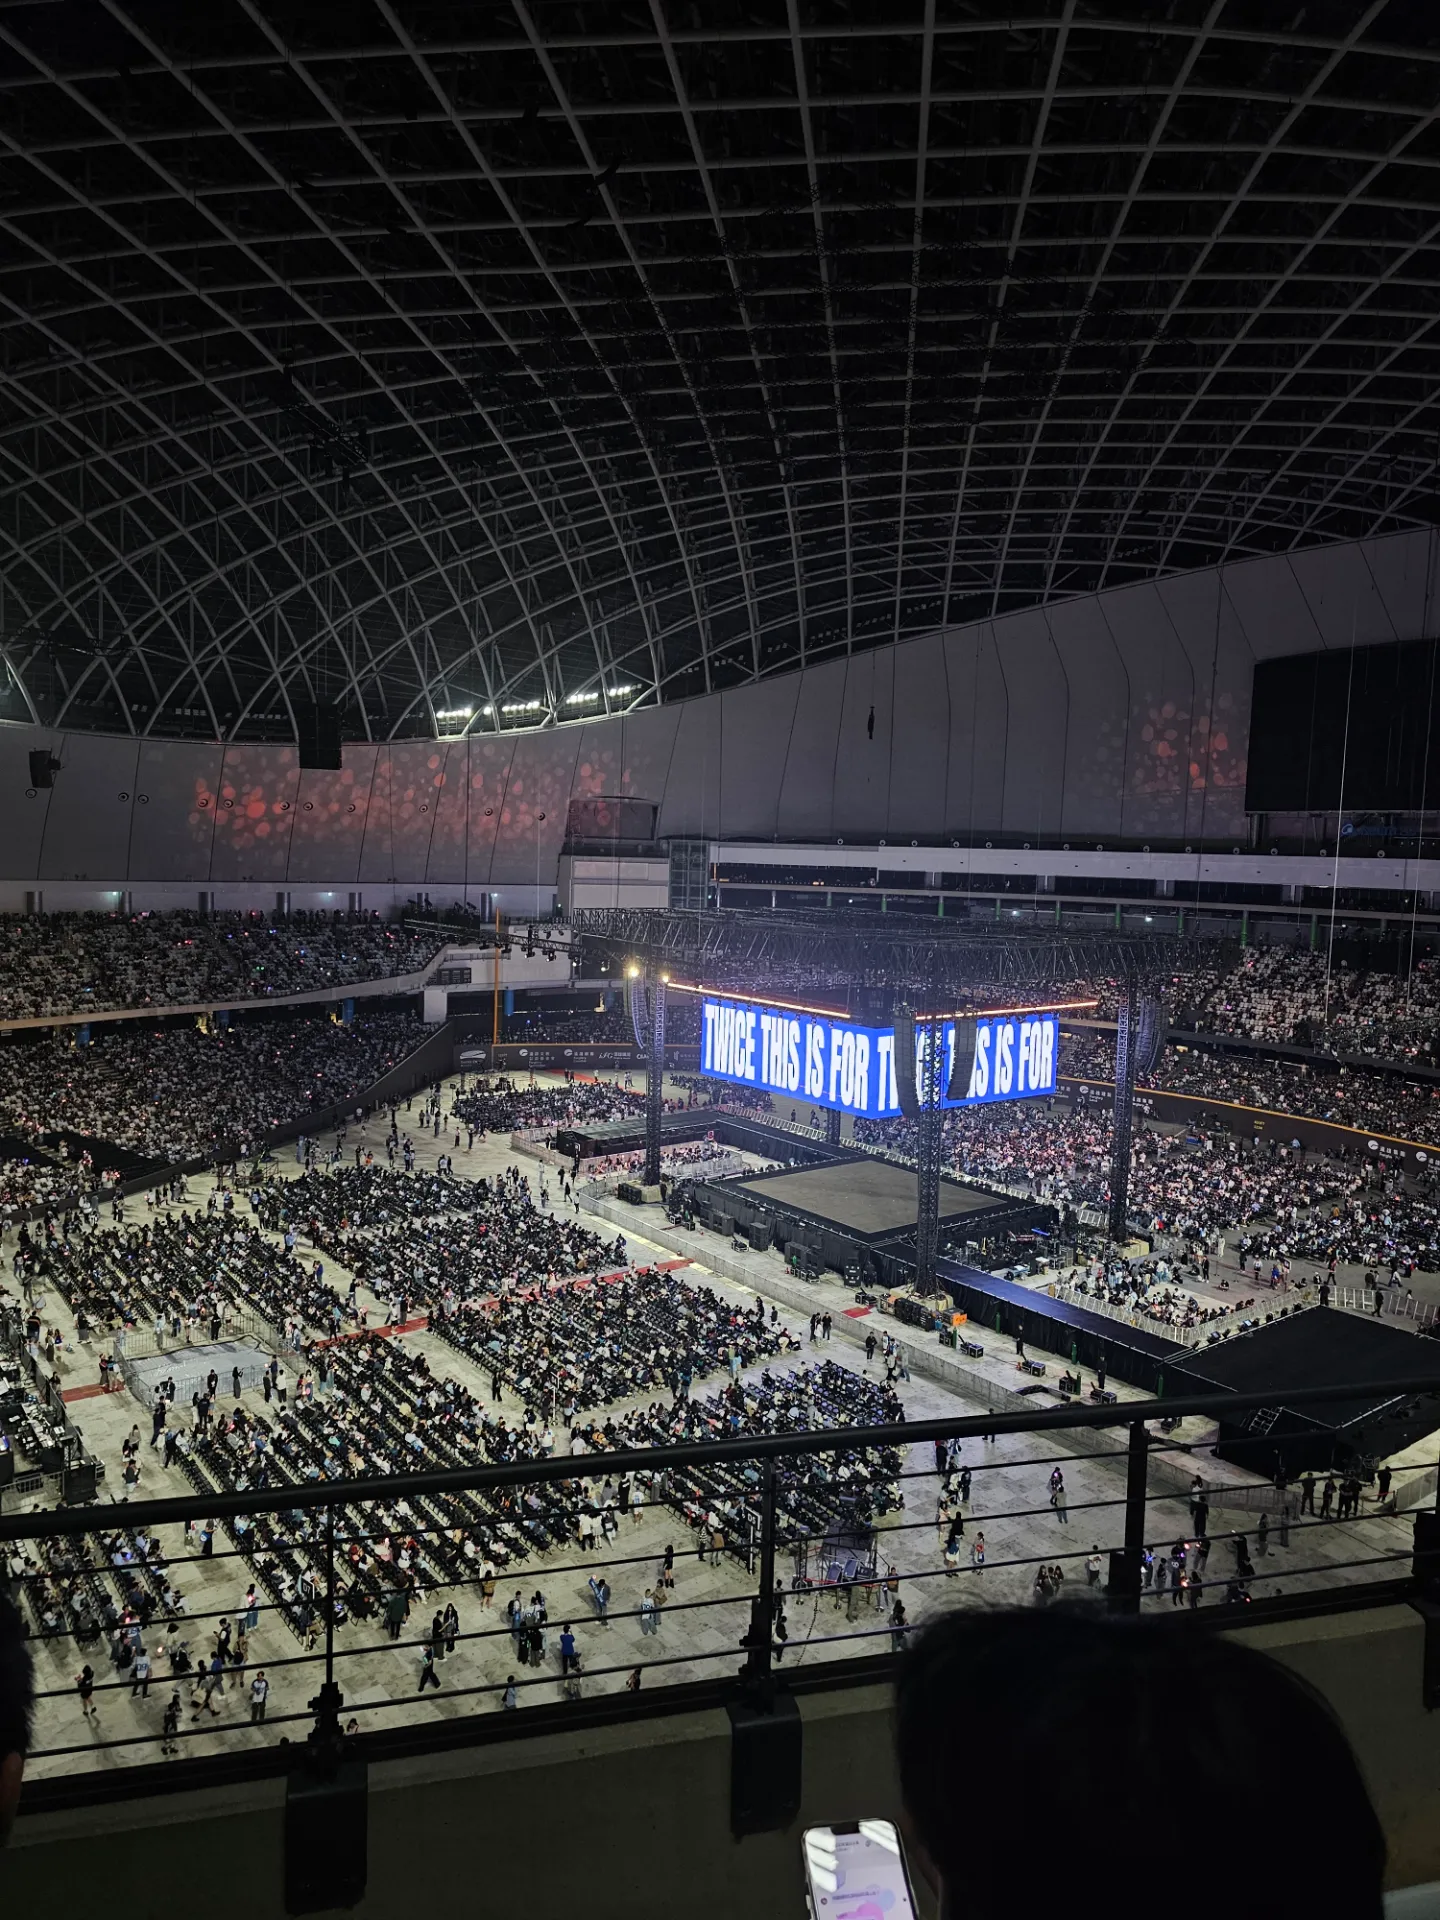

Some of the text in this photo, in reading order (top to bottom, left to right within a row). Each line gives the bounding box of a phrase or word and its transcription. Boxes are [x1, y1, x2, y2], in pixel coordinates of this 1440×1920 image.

[704, 1003, 870, 1112] TWICE THIS IS FOR
[994, 1022, 1015, 1095] IS
[1018, 1020, 1055, 1092] FOR
